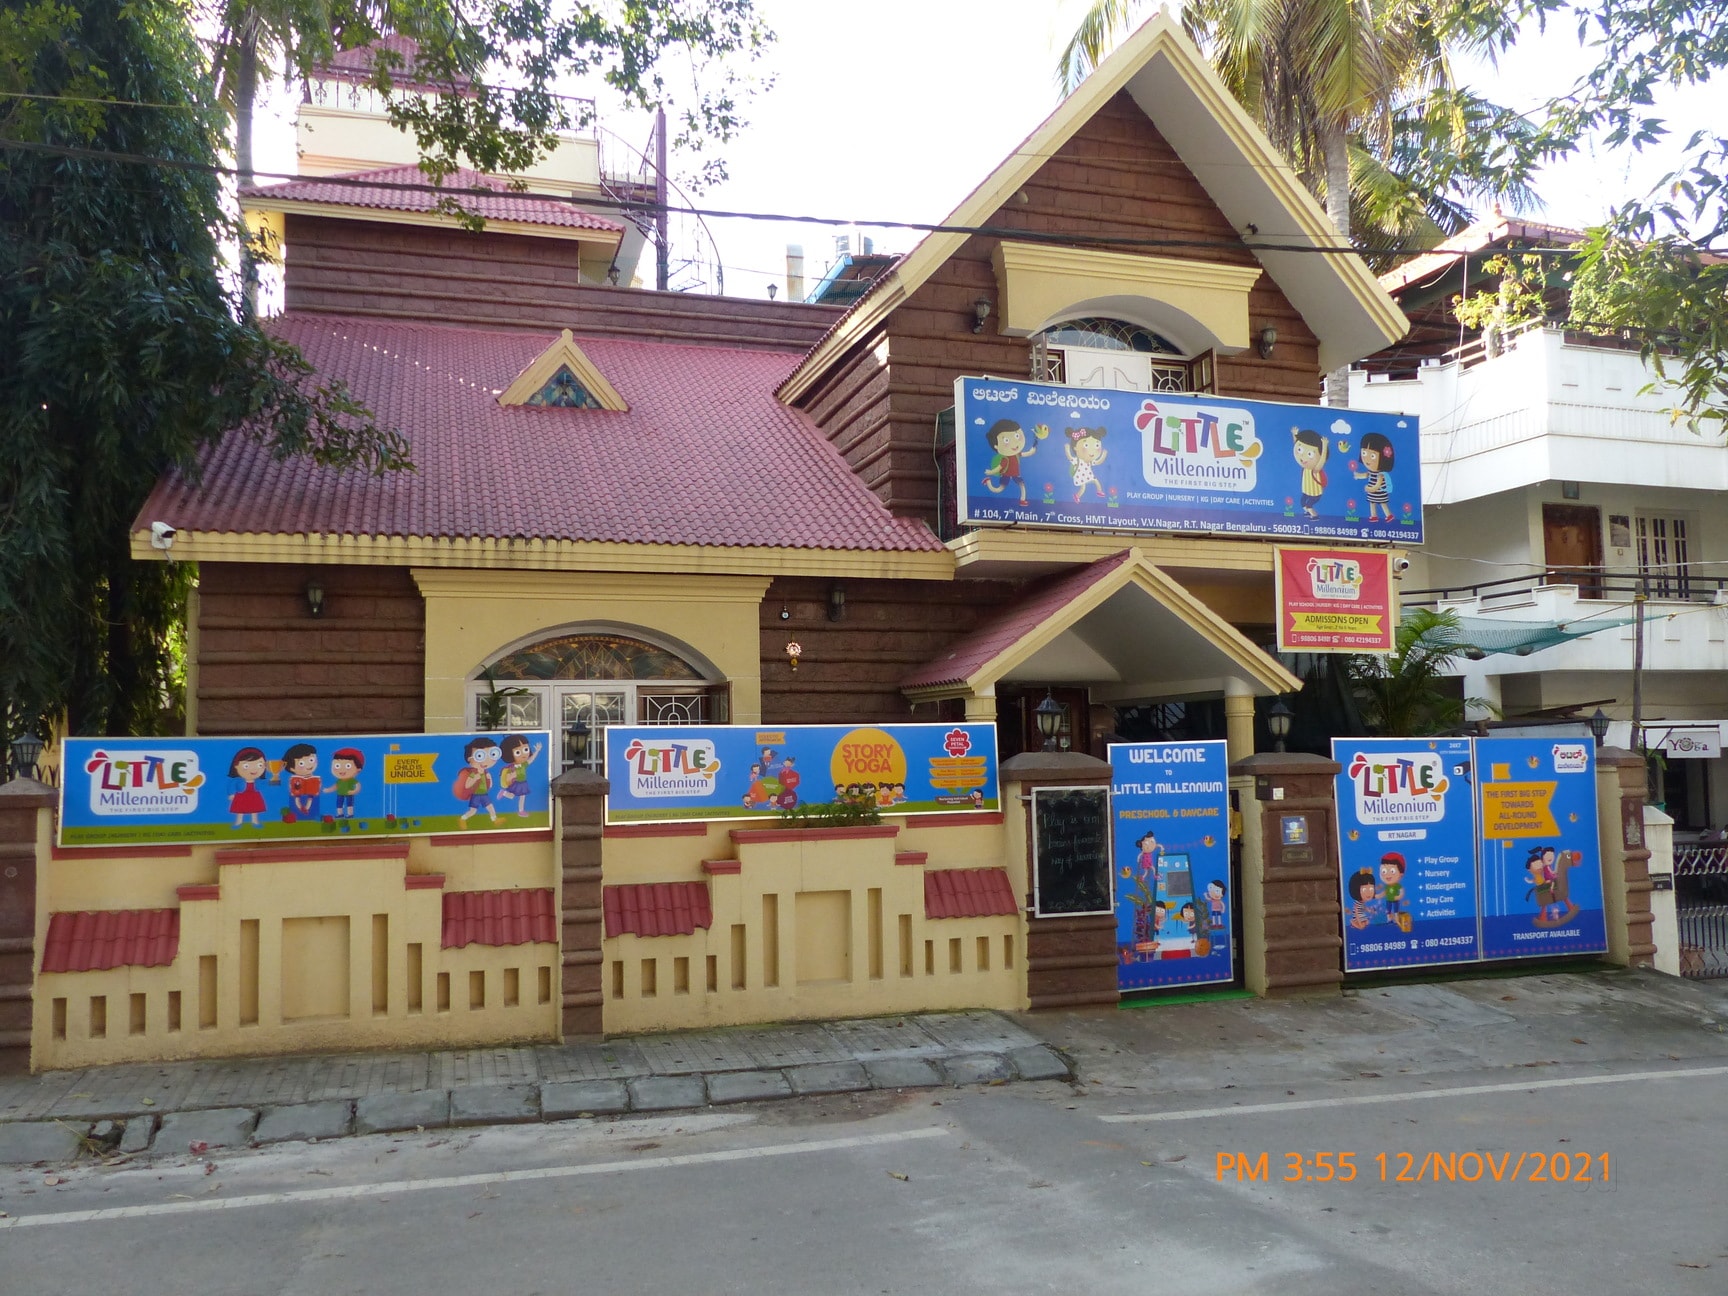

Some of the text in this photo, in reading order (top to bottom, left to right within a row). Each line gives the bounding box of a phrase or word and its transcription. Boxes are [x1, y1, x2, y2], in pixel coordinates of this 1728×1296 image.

[972, 388, 1018, 402] ಲಿಟಲ್
[1153, 458, 1246, 480] Millennium
[1142, 492, 1164, 500] GROUP
[1226, 497, 1240, 505] CARE
[982, 509, 1001, 520] 104,
[1015, 511, 1038, 520] Main
[1057, 513, 1084, 524] Cross,
[1085, 515, 1106, 524] HMT
[1108, 516, 1140, 528] Layout,
[1141, 518, 1182, 529] V.V.Nagar,
[1184, 520, 1198, 528] R.T.
[1200, 521, 1224, 531] Nagar
[1226, 522, 1266, 532] Bengaluru
[1314, 526, 1336, 535] 98806
[1336, 528, 1358, 536] 84989
[1374, 530, 1386, 538] 080
[1387, 530, 1418, 539] 42194337
[1316, 584, 1356, 594] Millennium
[1348, 616, 1369, 624] OPEN
[842, 744, 894, 759] STORY
[1129, 748, 1206, 764] WELCOME
[844, 758, 892, 774] YOGA
[390, 770, 425, 778] UNIQUE
[637, 776, 708, 789] Millennium
[1114, 782, 1222, 795] LITTLE MILLENNIUM
[100, 792, 188, 806] Millennium
[1500, 790, 1518, 798] FIRST
[1364, 798, 1436, 814] Millennium
[1120, 810, 1170, 819] PRESCHOOL
[1181, 808, 1219, 817] DAYCARE
[1494, 821, 1543, 830] DEVELOPMENT
[1424, 856, 1459, 865] Play Group
[1424, 870, 1450, 878] Nursery
[1425, 882, 1466, 891] Kindergarten
[1426, 897, 1438, 905] Day
[1426, 909, 1456, 917] Activities
[1512, 929, 1580, 940] TRANSPORT AVAILABLE
[1360, 944, 1383, 952] 98806
[1384, 941, 1406, 950] 84989
[1425, 938, 1438, 947] 080
[1439, 936, 1473, 946] 42194337
